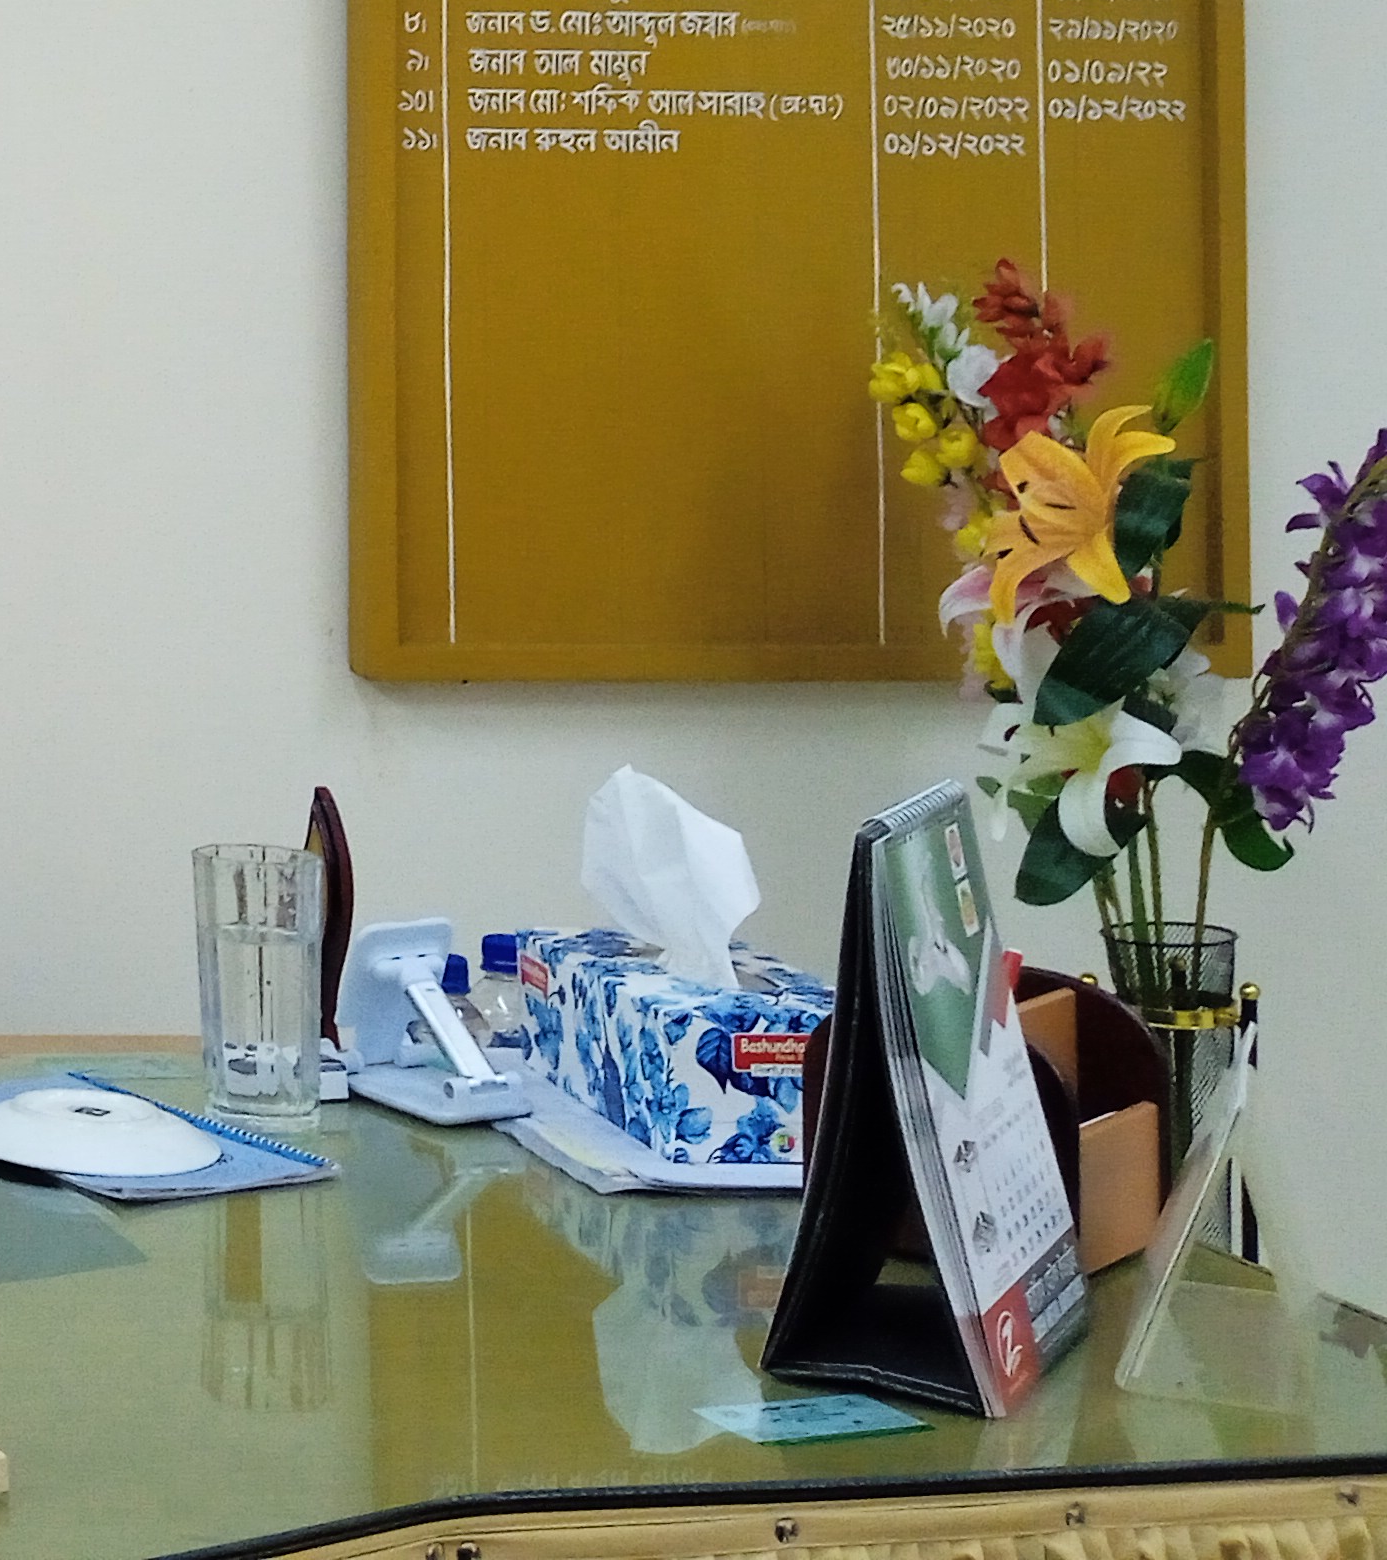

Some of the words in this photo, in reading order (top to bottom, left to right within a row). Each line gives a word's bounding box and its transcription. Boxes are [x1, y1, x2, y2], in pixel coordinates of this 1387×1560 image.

[466, 12, 526, 34] জনাব
[529, 11, 555, 33] ড.
[560, 11, 602, 35] মোঃ
[469, 50, 527, 74] জনাব
[534, 50, 583, 76] আল
[590, 51, 651, 86] মামুন
[468, 89, 527, 114] জনাব
[571, 83, 643, 115] শফিক
[648, 91, 695, 115] আল
[696, 91, 766, 119] সারাহ
[466, 128, 529, 151] জনাব
[604, 120, 681, 153] আমীন
